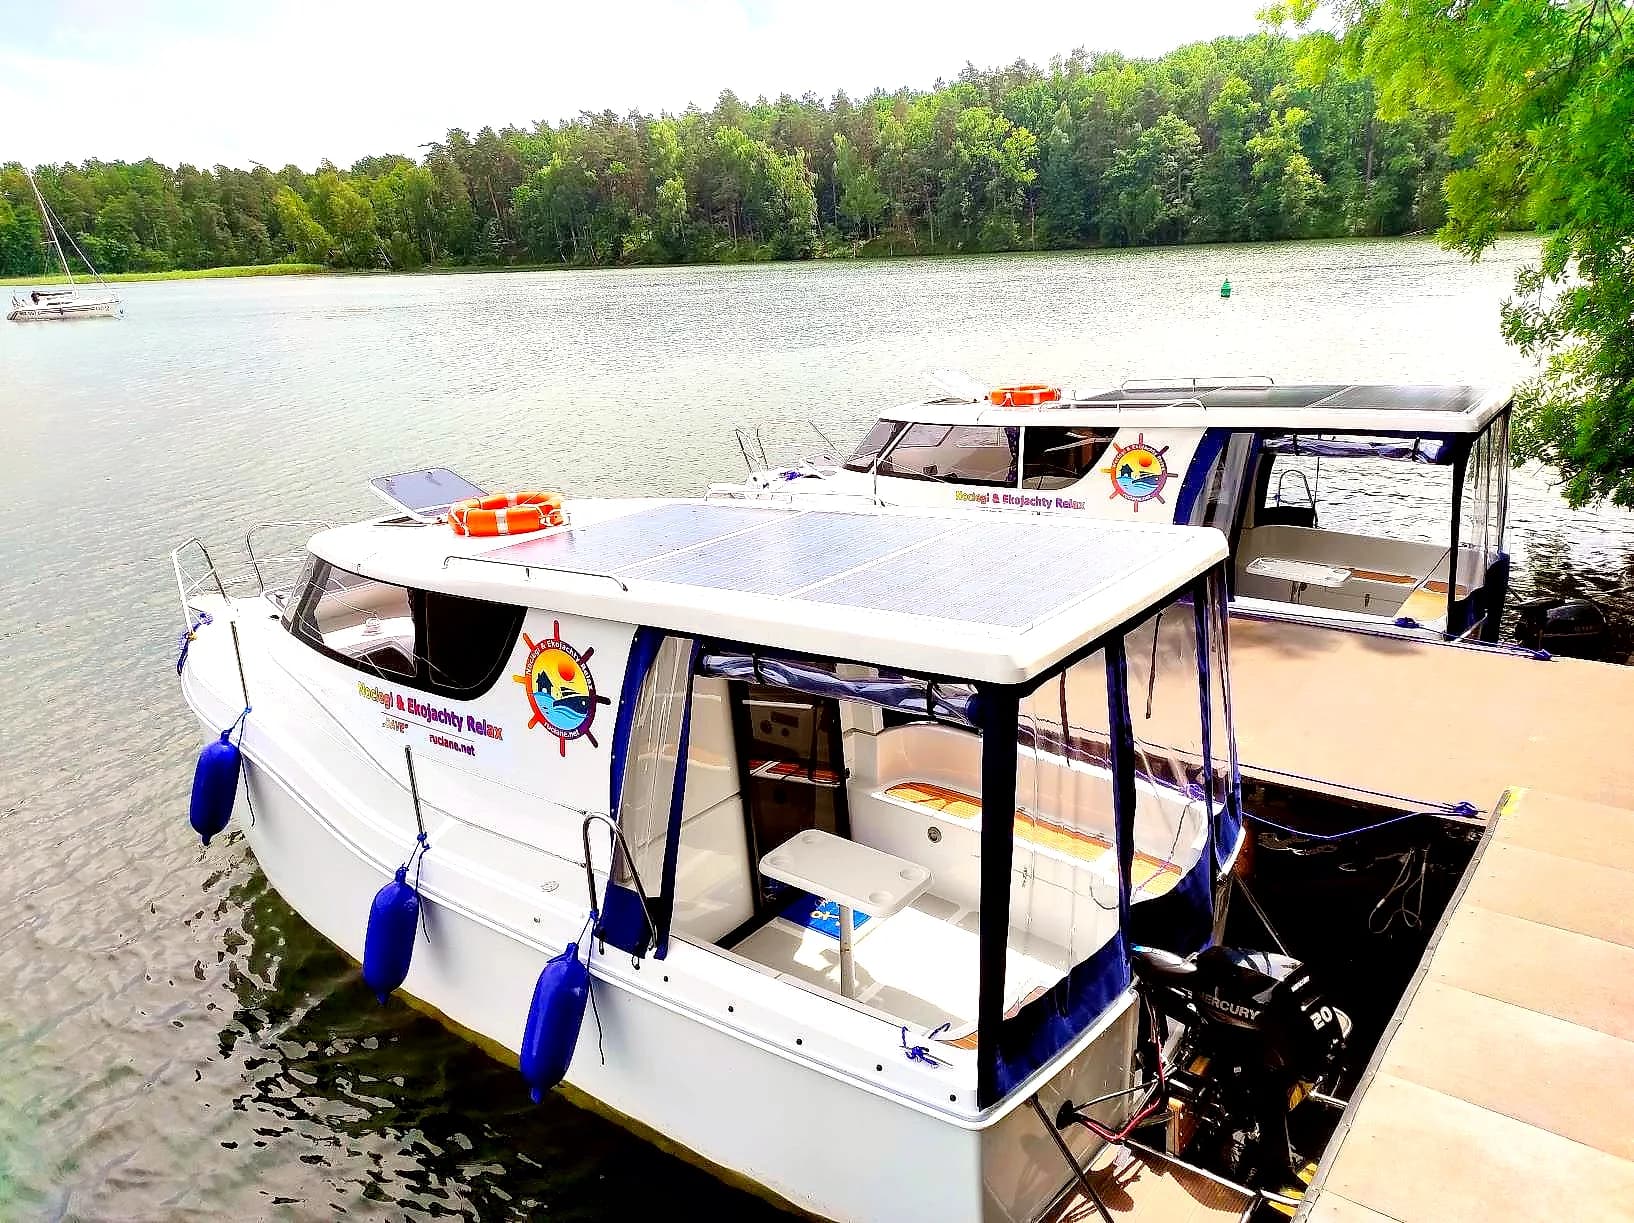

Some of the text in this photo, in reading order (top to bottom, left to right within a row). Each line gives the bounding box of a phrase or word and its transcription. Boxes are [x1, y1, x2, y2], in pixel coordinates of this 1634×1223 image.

[992, 493, 1001, 504] &
[1002, 494, 1053, 509] Ekojachty
[1055, 497, 1087, 510] Relax
[396, 694, 406, 711] &
[407, 697, 464, 732] Ekojachty
[466, 715, 504, 741] Relax
[428, 733, 476, 757] ruciane.net
[1309, 1006, 1333, 1031] 20
